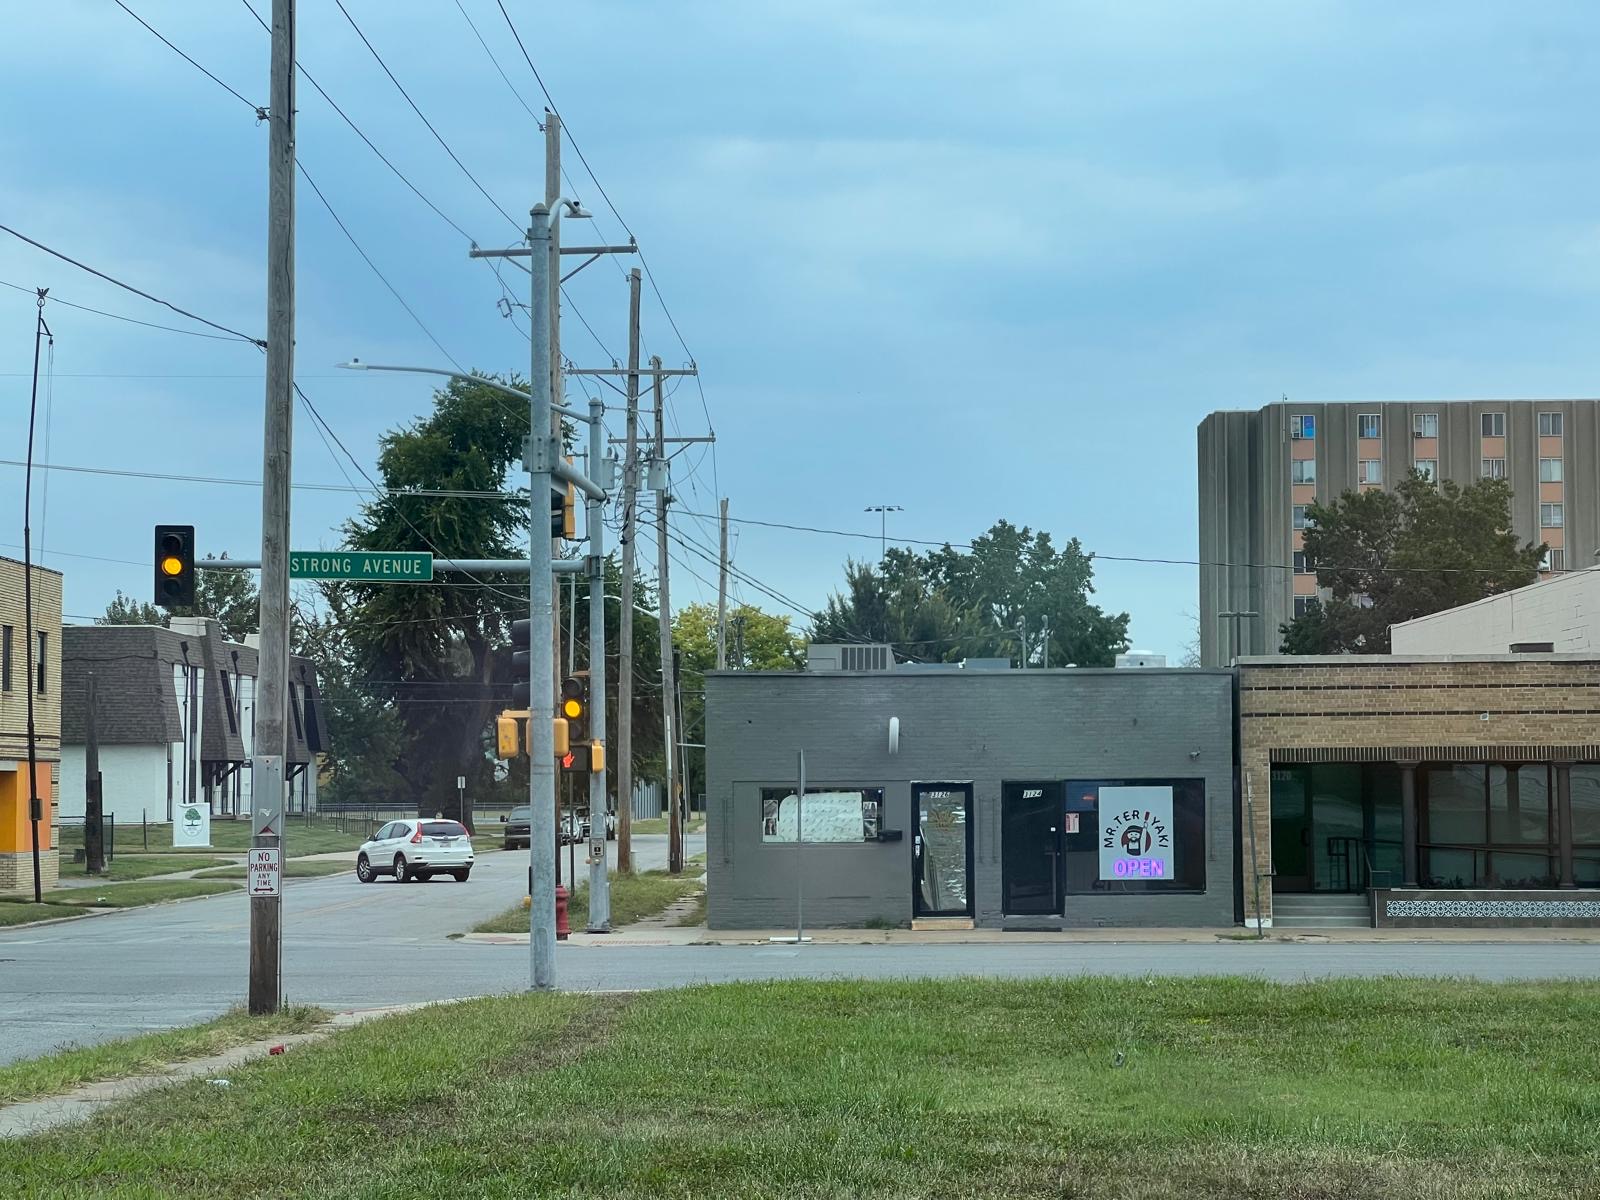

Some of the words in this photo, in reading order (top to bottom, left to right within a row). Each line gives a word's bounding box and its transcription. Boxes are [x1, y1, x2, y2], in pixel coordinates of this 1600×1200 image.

[291, 558, 352, 573] STRONG
[362, 559, 422, 574] AVENUE
[258, 852, 270, 862] NO
[250, 862, 278, 872] PARKING
[1113, 858, 1164, 878] OPEN
